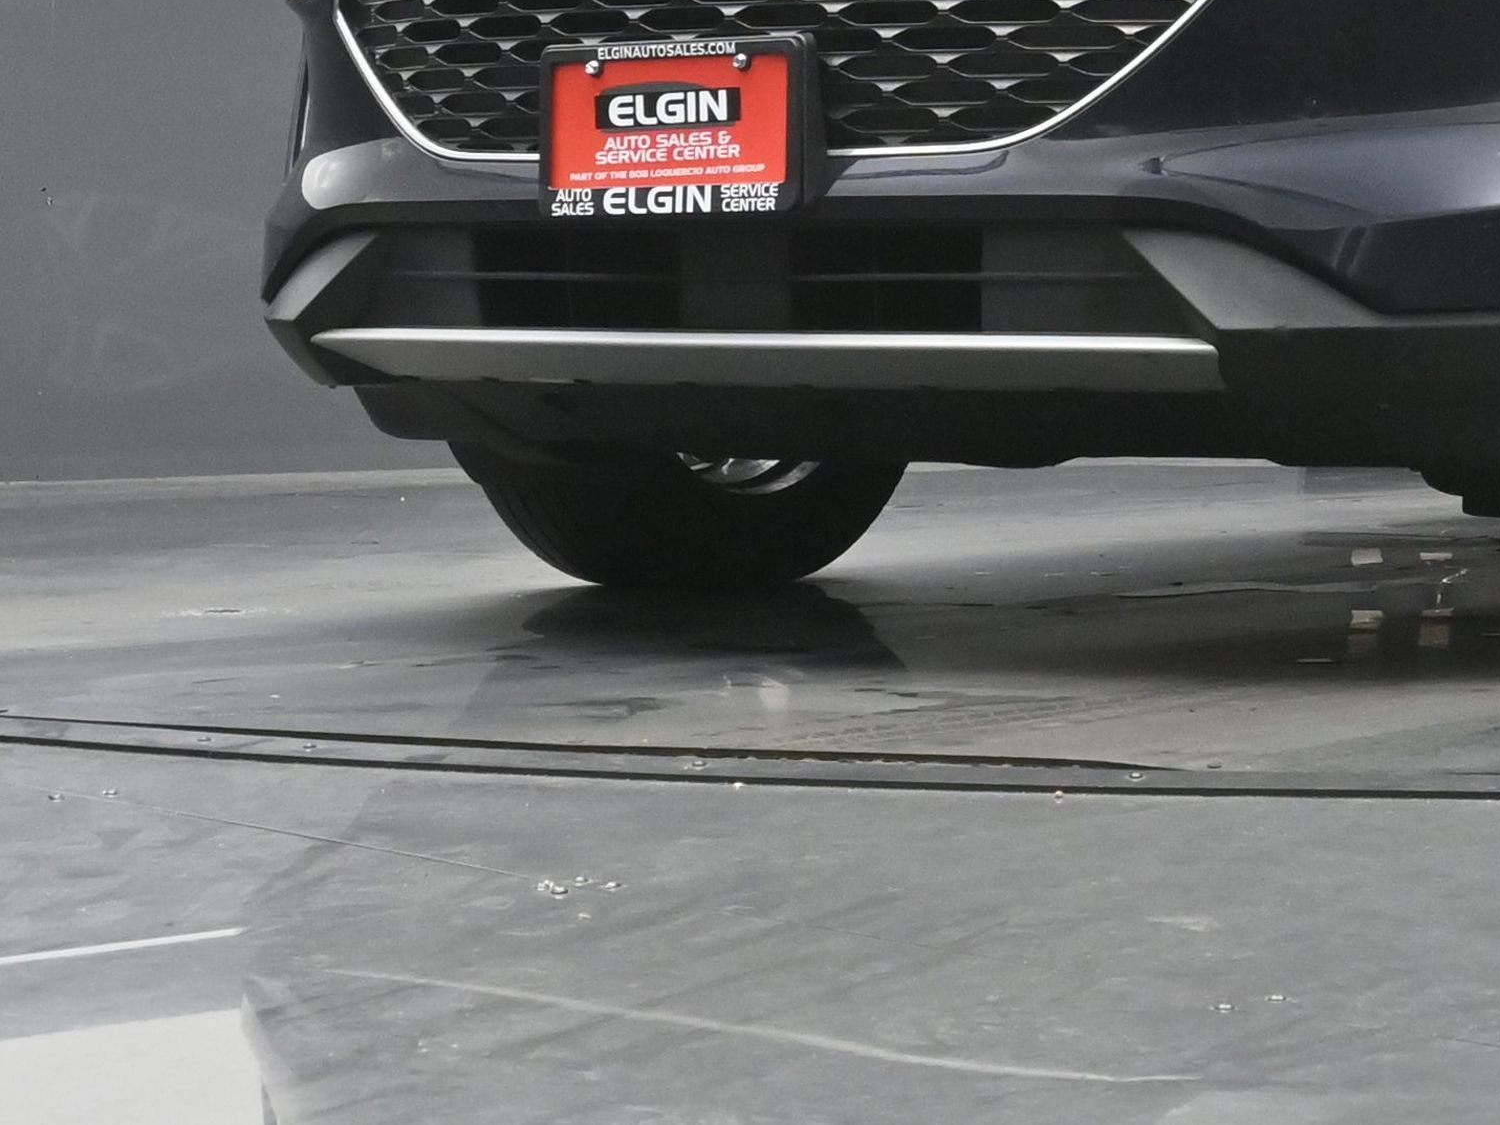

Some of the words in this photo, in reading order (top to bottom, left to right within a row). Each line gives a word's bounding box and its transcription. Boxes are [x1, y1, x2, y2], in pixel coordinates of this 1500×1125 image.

[598, 42, 736, 60] ELGINAUTOSALES.COM
[608, 89, 728, 127] ELGIN
[604, 135, 650, 152] AUTO
[655, 131, 712, 148] SALES
[718, 130, 732, 145] &
[595, 147, 667, 165] SERVICE
[672, 144, 740, 161] CENTER
[555, 187, 592, 203] AUTO
[720, 183, 779, 198] SERVICE
[551, 201, 595, 217] SALES
[603, 185, 712, 215] ELGIN
[722, 197, 776, 212] CENTER
